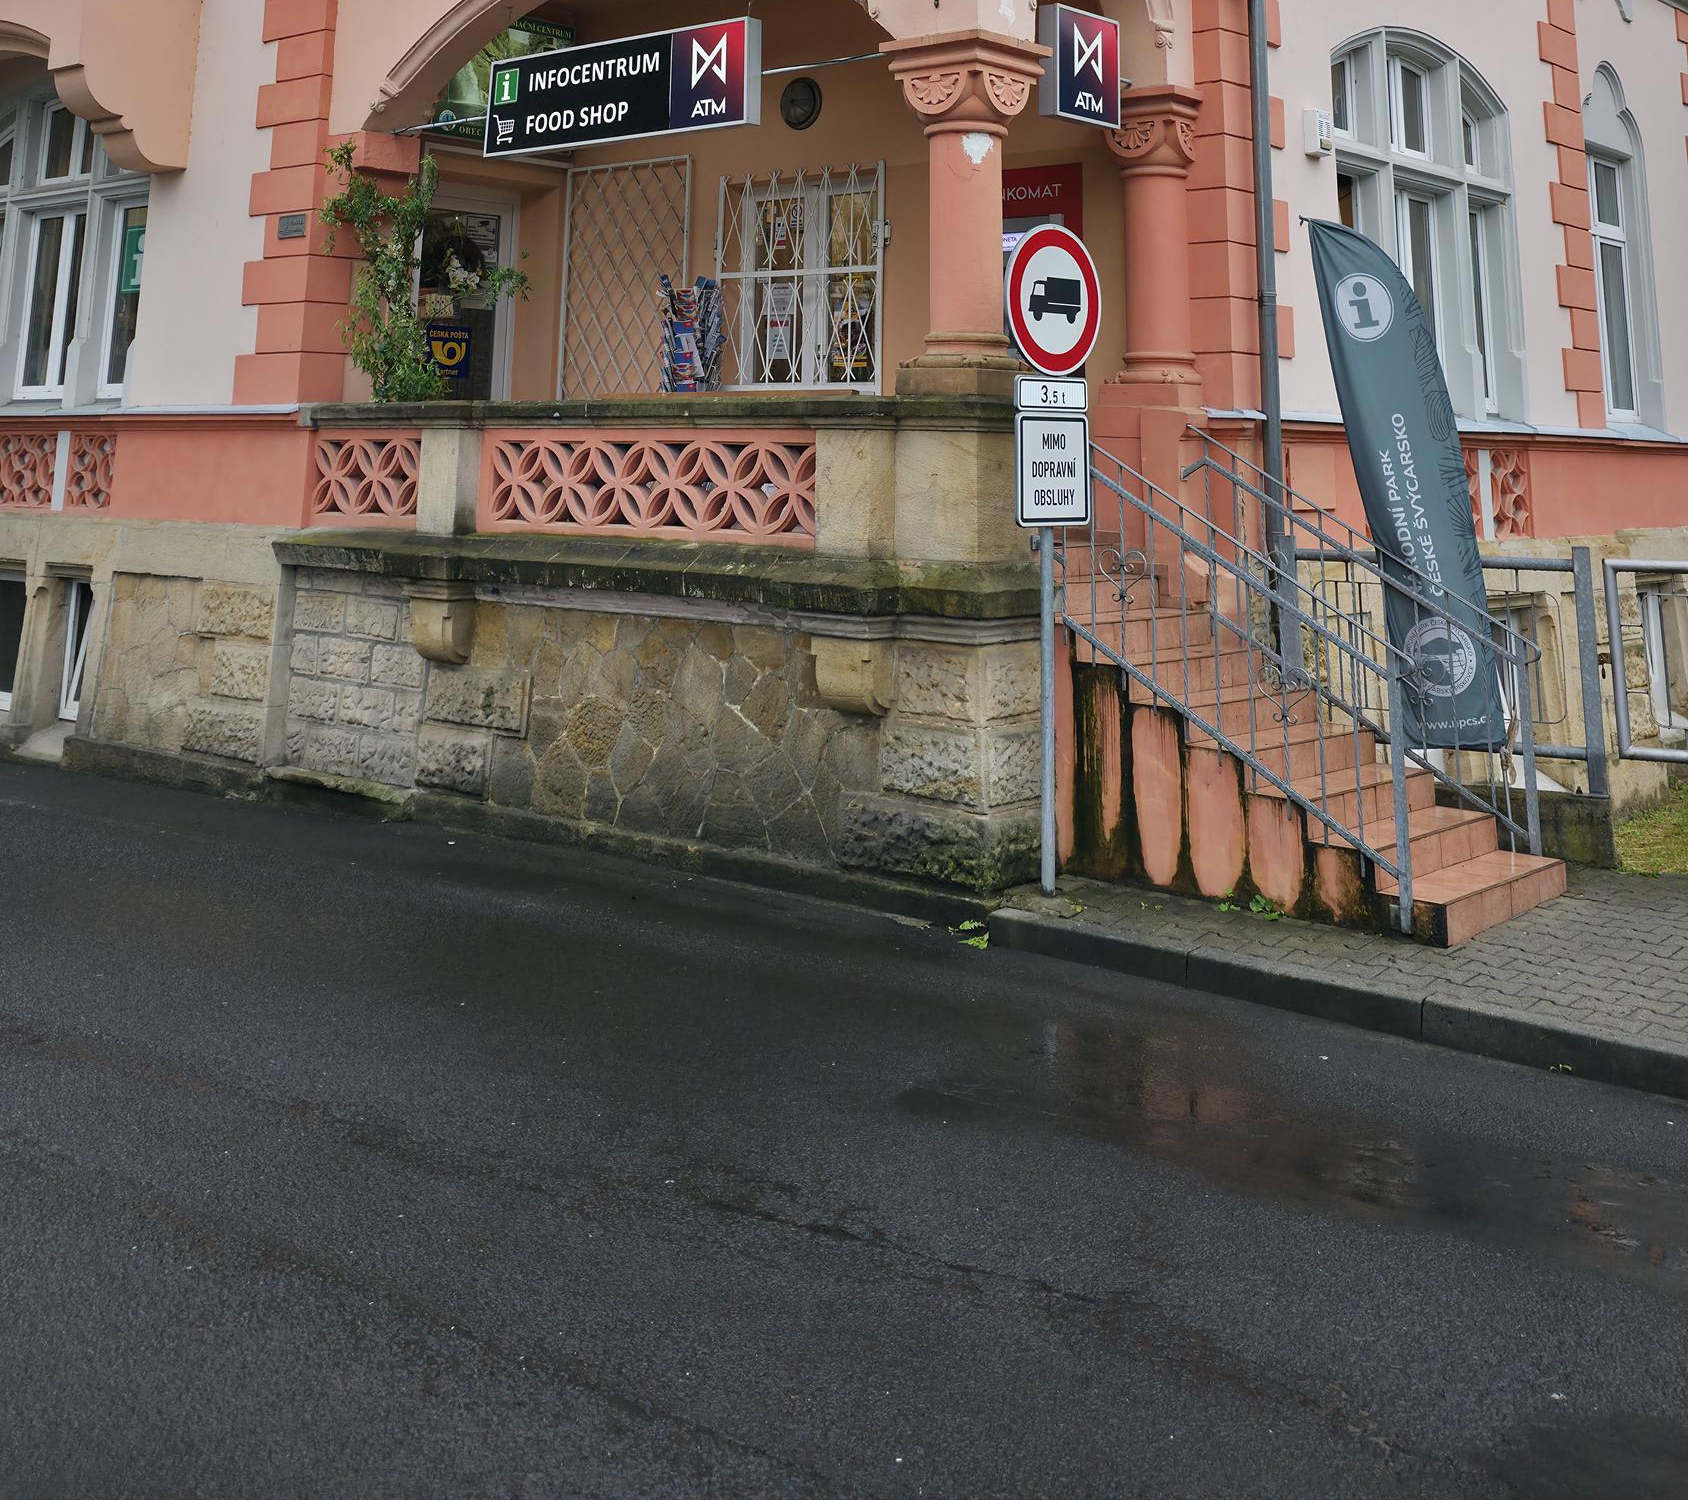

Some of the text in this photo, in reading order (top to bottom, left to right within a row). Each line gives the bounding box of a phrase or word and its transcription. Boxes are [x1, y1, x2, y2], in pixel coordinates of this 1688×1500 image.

[536, 25, 572, 39] CENTRUM
[529, 51, 660, 92] INFOCENTRUM
[691, 97, 726, 119] ATM
[1074, 90, 1103, 114] ATM
[525, 101, 629, 135] FOOD SHOP
[450, 330, 469, 339] POŠTA
[1040, 384, 1066, 404] 3,5 t
[1042, 433, 1066, 450] MIMO
[1032, 458, 1076, 478] DOPRAVNÍ
[1379, 449, 1401, 502] PARK
[1034, 489, 1075, 506] OBSLUHY
[1391, 413, 1445, 597] ČESKÉ ŠVÝCARSKO
